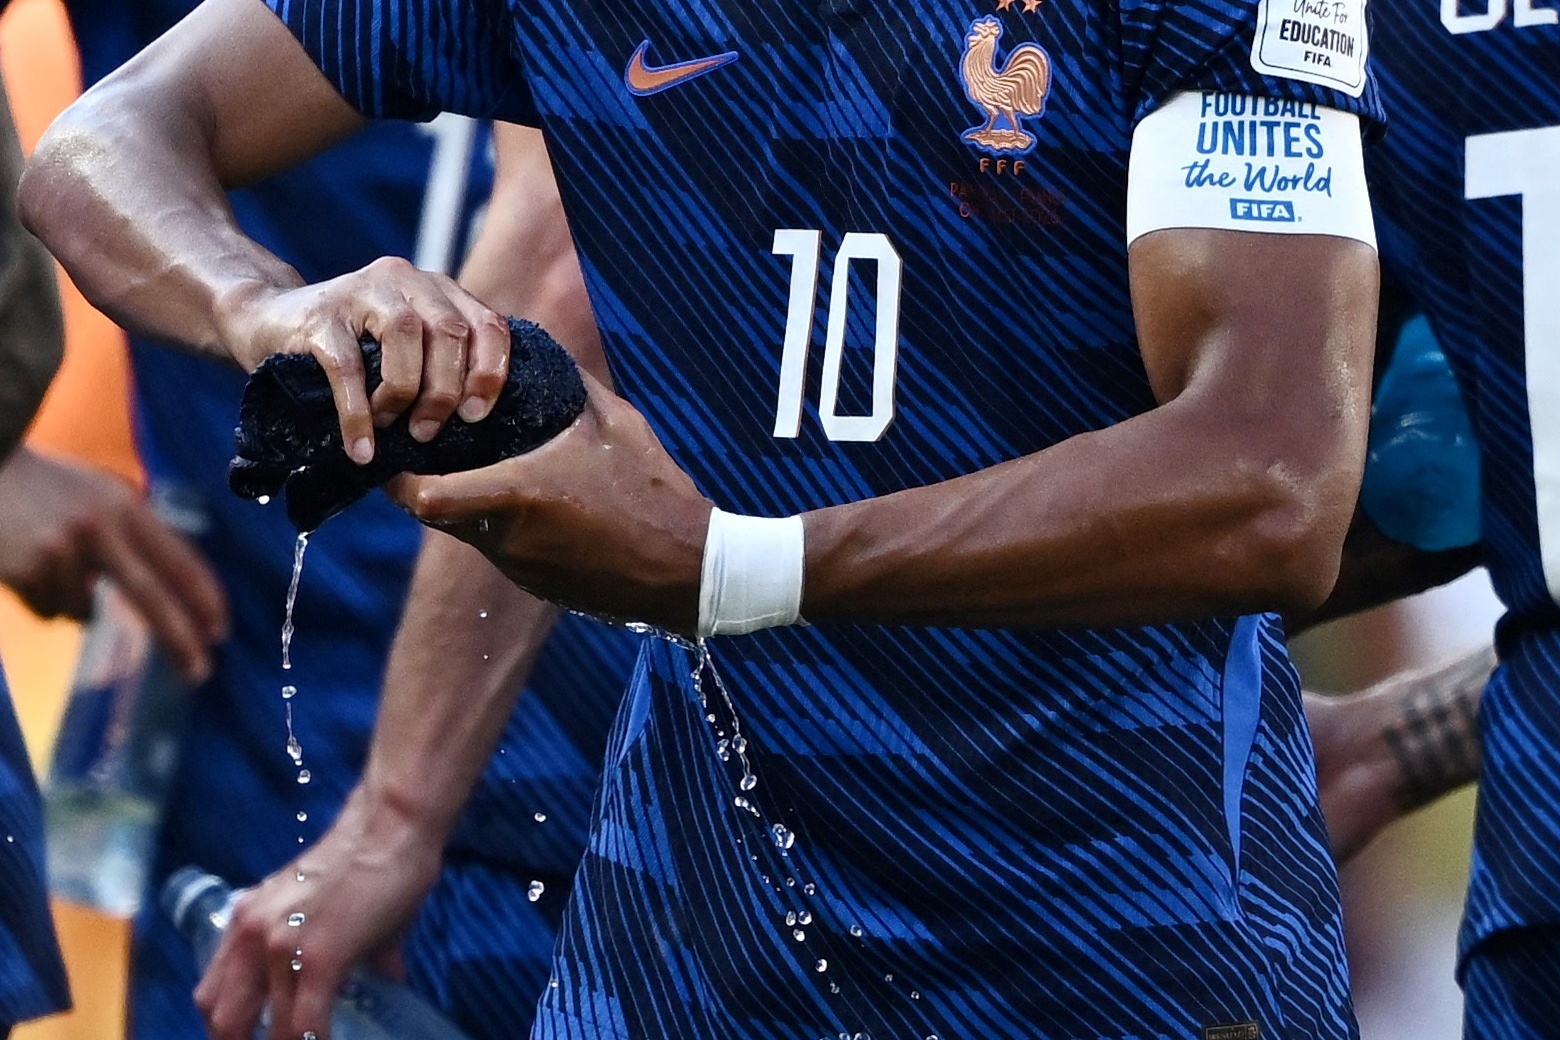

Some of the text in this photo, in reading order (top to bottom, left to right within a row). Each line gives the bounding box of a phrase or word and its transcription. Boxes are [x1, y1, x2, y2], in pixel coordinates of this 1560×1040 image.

[1332, 1, 1348, 25] For
[1279, 18, 1355, 58] EDUCATION
[1304, 50, 1331, 67] FIFA
[1196, 120, 1324, 159] UNITES
[1181, 158, 1332, 197] the World
[1233, 201, 1293, 220] FIFA
[772, 229, 902, 442] 10
